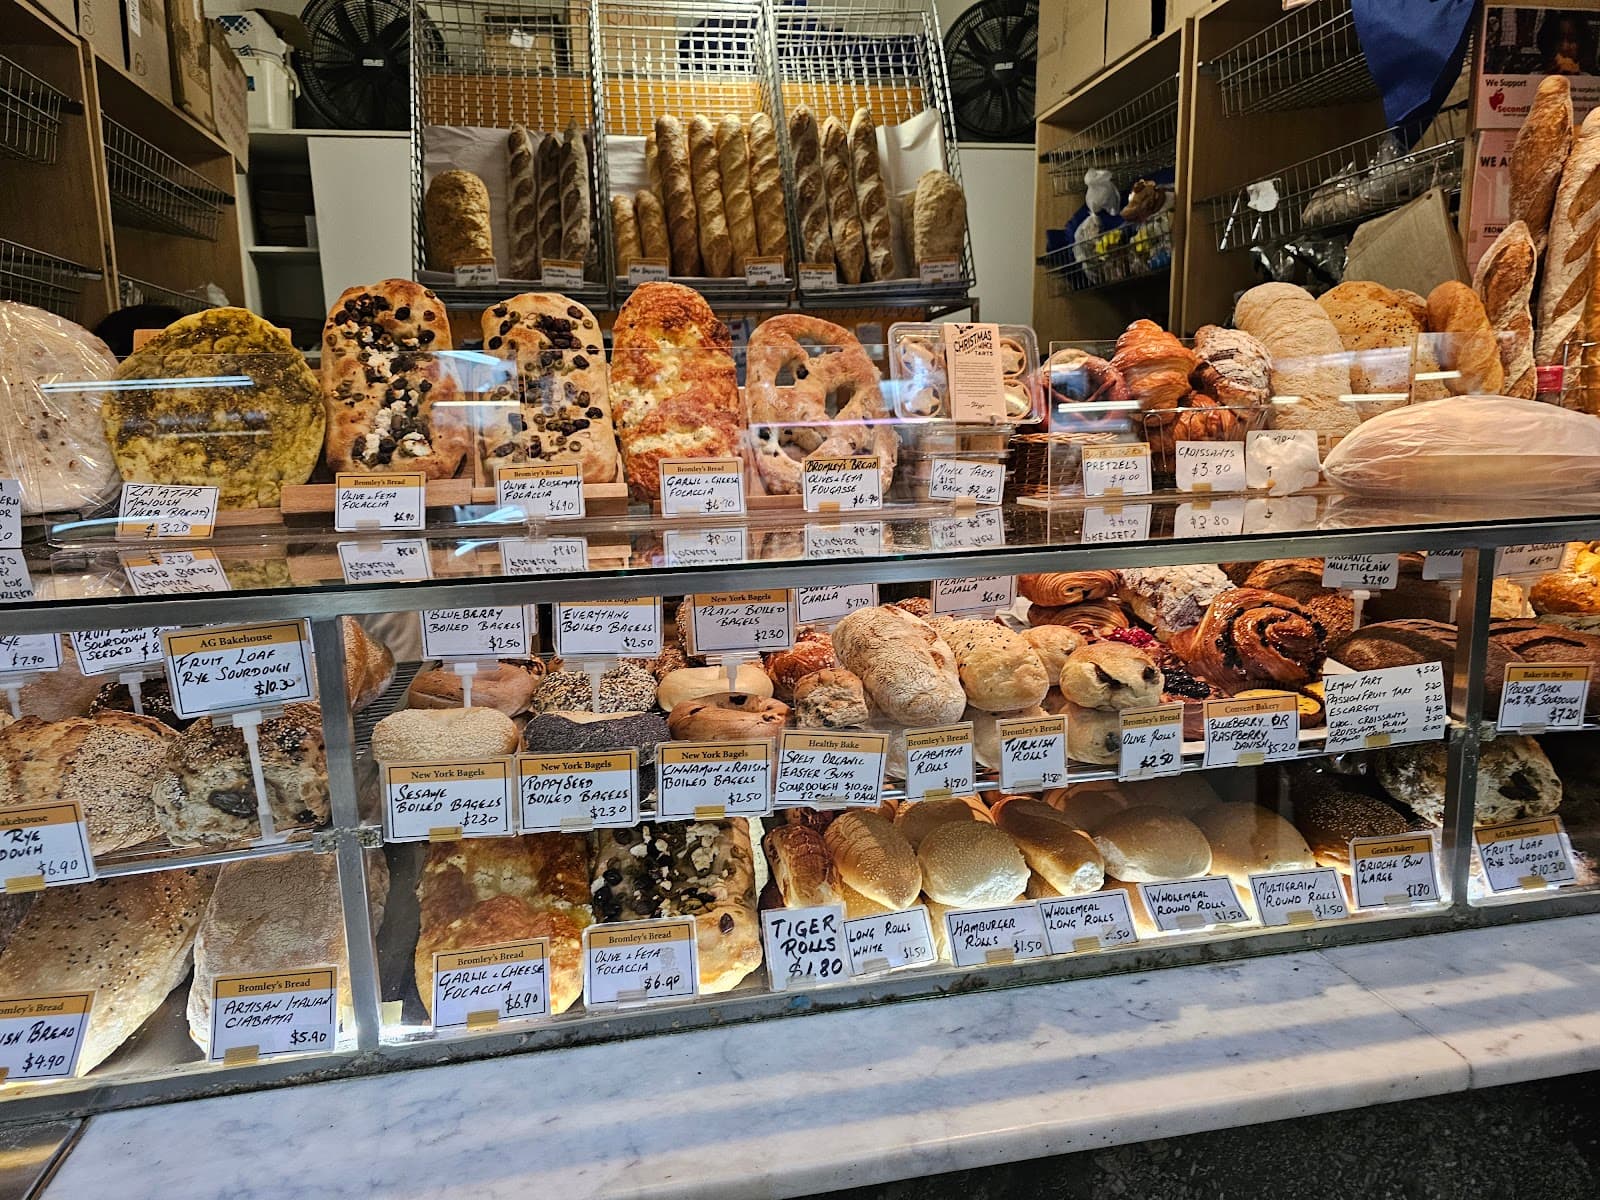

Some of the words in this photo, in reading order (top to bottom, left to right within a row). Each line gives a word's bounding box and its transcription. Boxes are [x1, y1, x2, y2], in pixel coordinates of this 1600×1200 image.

[1485, 79, 1498, 87] We
[1500, 79, 1527, 89] Support
[1481, 156, 1497, 167] WE
[954, 330, 992, 352] CHRISTMAS
[1178, 446, 1235, 459] CROISSANTS
[1086, 460, 1138, 472] PRETZELS
[1191, 462, 1231, 477] $3.80
[503, 480, 527, 490] OLIVE
[670, 487, 714, 497] FOCACCIA
[810, 484, 857, 495] FOUGASSE
[341, 490, 365, 500] OLIVE
[504, 490, 552, 501] FOCACCIA
[342, 500, 389, 510] FOCACCIA
[1327, 561, 1391, 572] MULTIGRAIN
[1360, 573, 1390, 586] $7.90
[729, 594, 746, 602] York
[747, 592, 772, 602] Bagels
[940, 583, 978, 596] CHALLA
[801, 591, 839, 605] CHALLA
[428, 609, 504, 621] BLUEBERRY
[562, 607, 631, 623] EVERYTHING
[698, 605, 740, 617] PLAIN
[744, 604, 786, 616] BOILED
[428, 623, 469, 634] BOILED
[477, 621, 521, 632] BAGELS
[561, 620, 603, 633] BOILED
[607, 621, 652, 634] BAGELS
[715, 616, 761, 627] BAGELS
[200, 640, 216, 648] AG
[219, 633, 273, 646] Bakehouse
[623, 636, 655, 649] $2.50
[12, 652, 45, 667] $7.90
[87, 646, 132, 661] SEEDED
[176, 651, 224, 673] FRUIT
[235, 648, 276, 665] LOAF
[181, 671, 210, 687] RYE
[215, 662, 292, 681] SOURDOUGH
[253, 679, 296, 698] $10.30
[1324, 679, 1358, 694] LEMON
[1359, 674, 1383, 687] TART
[1391, 686, 1413, 698] TART
[1329, 704, 1381, 717] ESCARGOT
[1357, 711, 1407, 725] CROISSANTS
[1002, 726, 1038, 736] Bromley's
[1040, 724, 1062, 733] Bread
[1209, 716, 1265, 730] BLUEBERRY
[1381, 718, 1409, 730] PLAIN
[908, 736, 945, 747] Bromley's
[947, 733, 969, 742] Bread
[1122, 733, 1146, 745] OLIVE
[1211, 728, 1268, 743] RASPBERRY
[808, 739, 839, 749] Healthy
[840, 740, 860, 748] Bake
[1005, 737, 1058, 753] TURKISH
[681, 752, 699, 760] New
[723, 749, 749, 759] Bagels
[822, 752, 865, 765] ORGANIC
[910, 746, 963, 762] CIABATTA
[1011, 750, 1048, 762] ROLLS
[541, 763, 560, 771] New
[562, 761, 583, 769] York
[585, 759, 611, 771] Bagels
[663, 764, 722, 777] CINNAMON
[731, 761, 770, 773] RAISIN
[914, 761, 948, 776] ROLLS
[411, 770, 430, 779] New
[433, 769, 453, 777] York
[456, 767, 485, 778] Bagels
[782, 767, 821, 779] EASTER
[823, 767, 854, 780] BUNS
[664, 777, 707, 789] BOILED
[714, 775, 755, 786] BAGELS
[778, 781, 839, 793] SOURDOUGH
[395, 784, 447, 802] SESAME
[526, 793, 572, 805] BOILED
[580, 790, 629, 802] BAGELS
[396, 801, 443, 814] BOILED
[450, 797, 502, 812] BAGELS
[590, 805, 627, 819] $2.30
[4, 828, 41, 846] RYE
[1482, 841, 1514, 856] FRUIT
[1519, 838, 1543, 850] LOAF
[1358, 859, 1398, 873] BRIOCHE
[1401, 855, 1424, 869] BUN
[1485, 858, 1504, 869] RYE
[1508, 849, 1560, 866] SOURDOUGH
[37, 859, 78, 876] $6.90
[1361, 872, 1393, 885] LARGE
[1149, 889, 1209, 904] WHOLEMEAL
[1258, 878, 1318, 901] MULTIGRAIN
[1265, 894, 1302, 908] ROUND
[1307, 890, 1337, 905] ROLLS
[1044, 903, 1100, 919] WHOLEMEAL
[1157, 905, 1191, 916] ROUND
[1197, 900, 1226, 912] ROLLS
[1214, 910, 1242, 921] $1.50
[1314, 903, 1343, 918] $1.50
[770, 914, 837, 940] TIGER
[953, 918, 1017, 939] HAMBURGER
[1049, 919, 1077, 931] LONG
[1083, 912, 1114, 926] ROLLS
[608, 934, 648, 945] Bromley's
[649, 930, 673, 940] Bread
[849, 927, 876, 943] LONG
[884, 920, 911, 937] ROLLS
[780, 937, 836, 959] ROLLS
[965, 934, 999, 950] ROLLS
[1013, 939, 1042, 954] $1.50
[456, 955, 498, 966] Bromley's
[499, 950, 525, 961] Bread
[594, 950, 622, 964] OLIVE
[634, 946, 661, 960] FETA
[852, 943, 884, 958] WHITE
[596, 962, 649, 976] FOCACCIA
[788, 956, 843, 978] $1.80
[438, 970, 488, 990] GARLIC
[500, 963, 545, 979] CHEESE
[643, 974, 680, 991] $6.90
[238, 981, 283, 993] Bromley's
[284, 978, 311, 988] Bread
[442, 981, 513, 1001] FOCACCIA
[36, 1002, 65, 1012] Bread
[223, 1000, 283, 1015] ARTISAN
[286, 994, 334, 1012] ITALIAN
[505, 993, 539, 1014] $6.90
[224, 1013, 294, 1029] CIABATTA
[27, 1020, 75, 1044] BREAD
[289, 1029, 328, 1046] $5.90
[22, 1051, 65, 1073] $4.90
